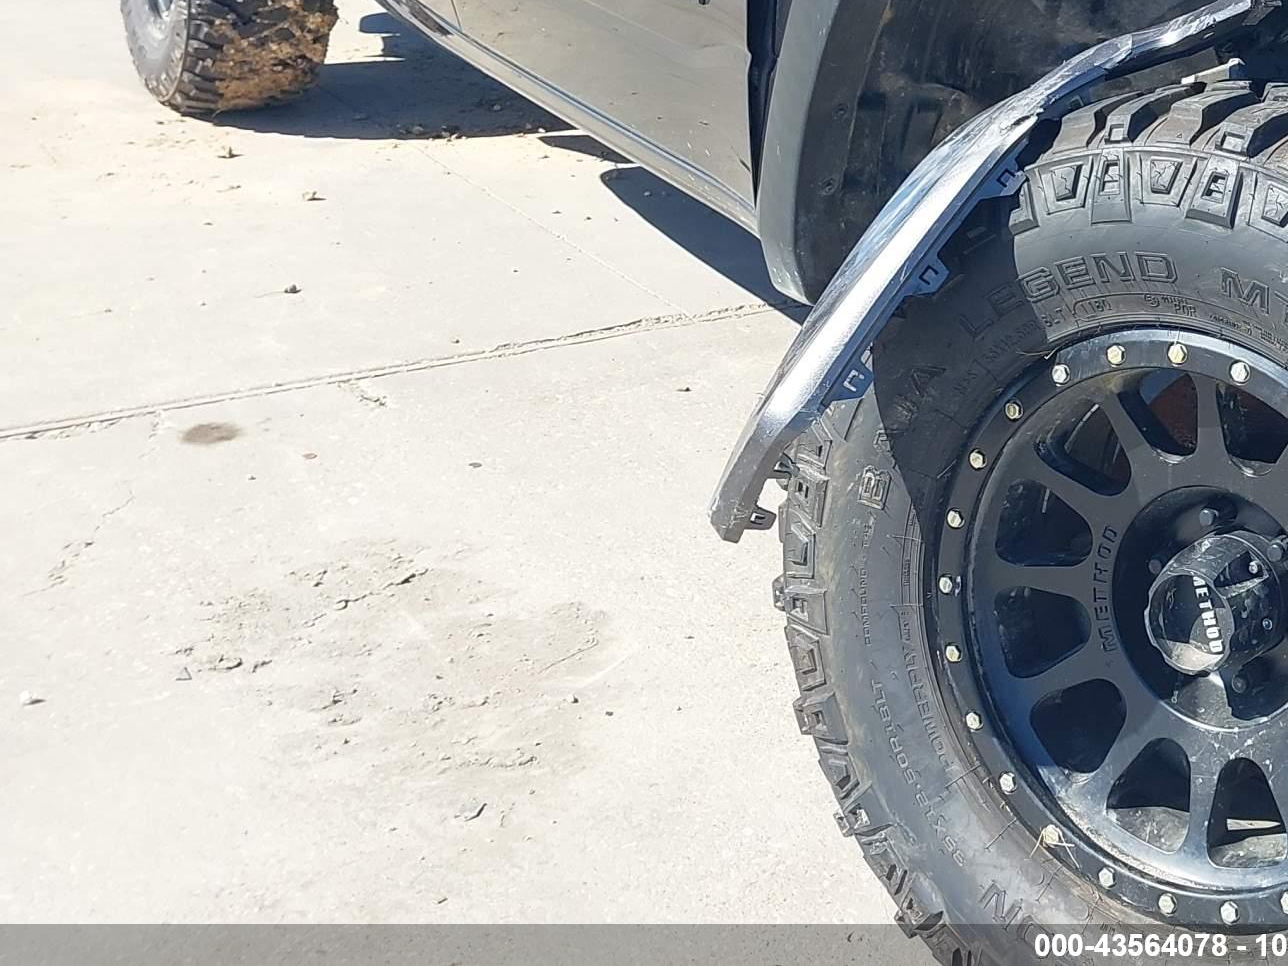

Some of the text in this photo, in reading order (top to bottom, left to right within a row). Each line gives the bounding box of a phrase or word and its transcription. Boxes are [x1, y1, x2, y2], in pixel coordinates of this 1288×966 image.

[957, 250, 1178, 337] LEGEND
[1093, 526, 1119, 654] METHOD
[1192, 574, 1224, 655] METHOD
